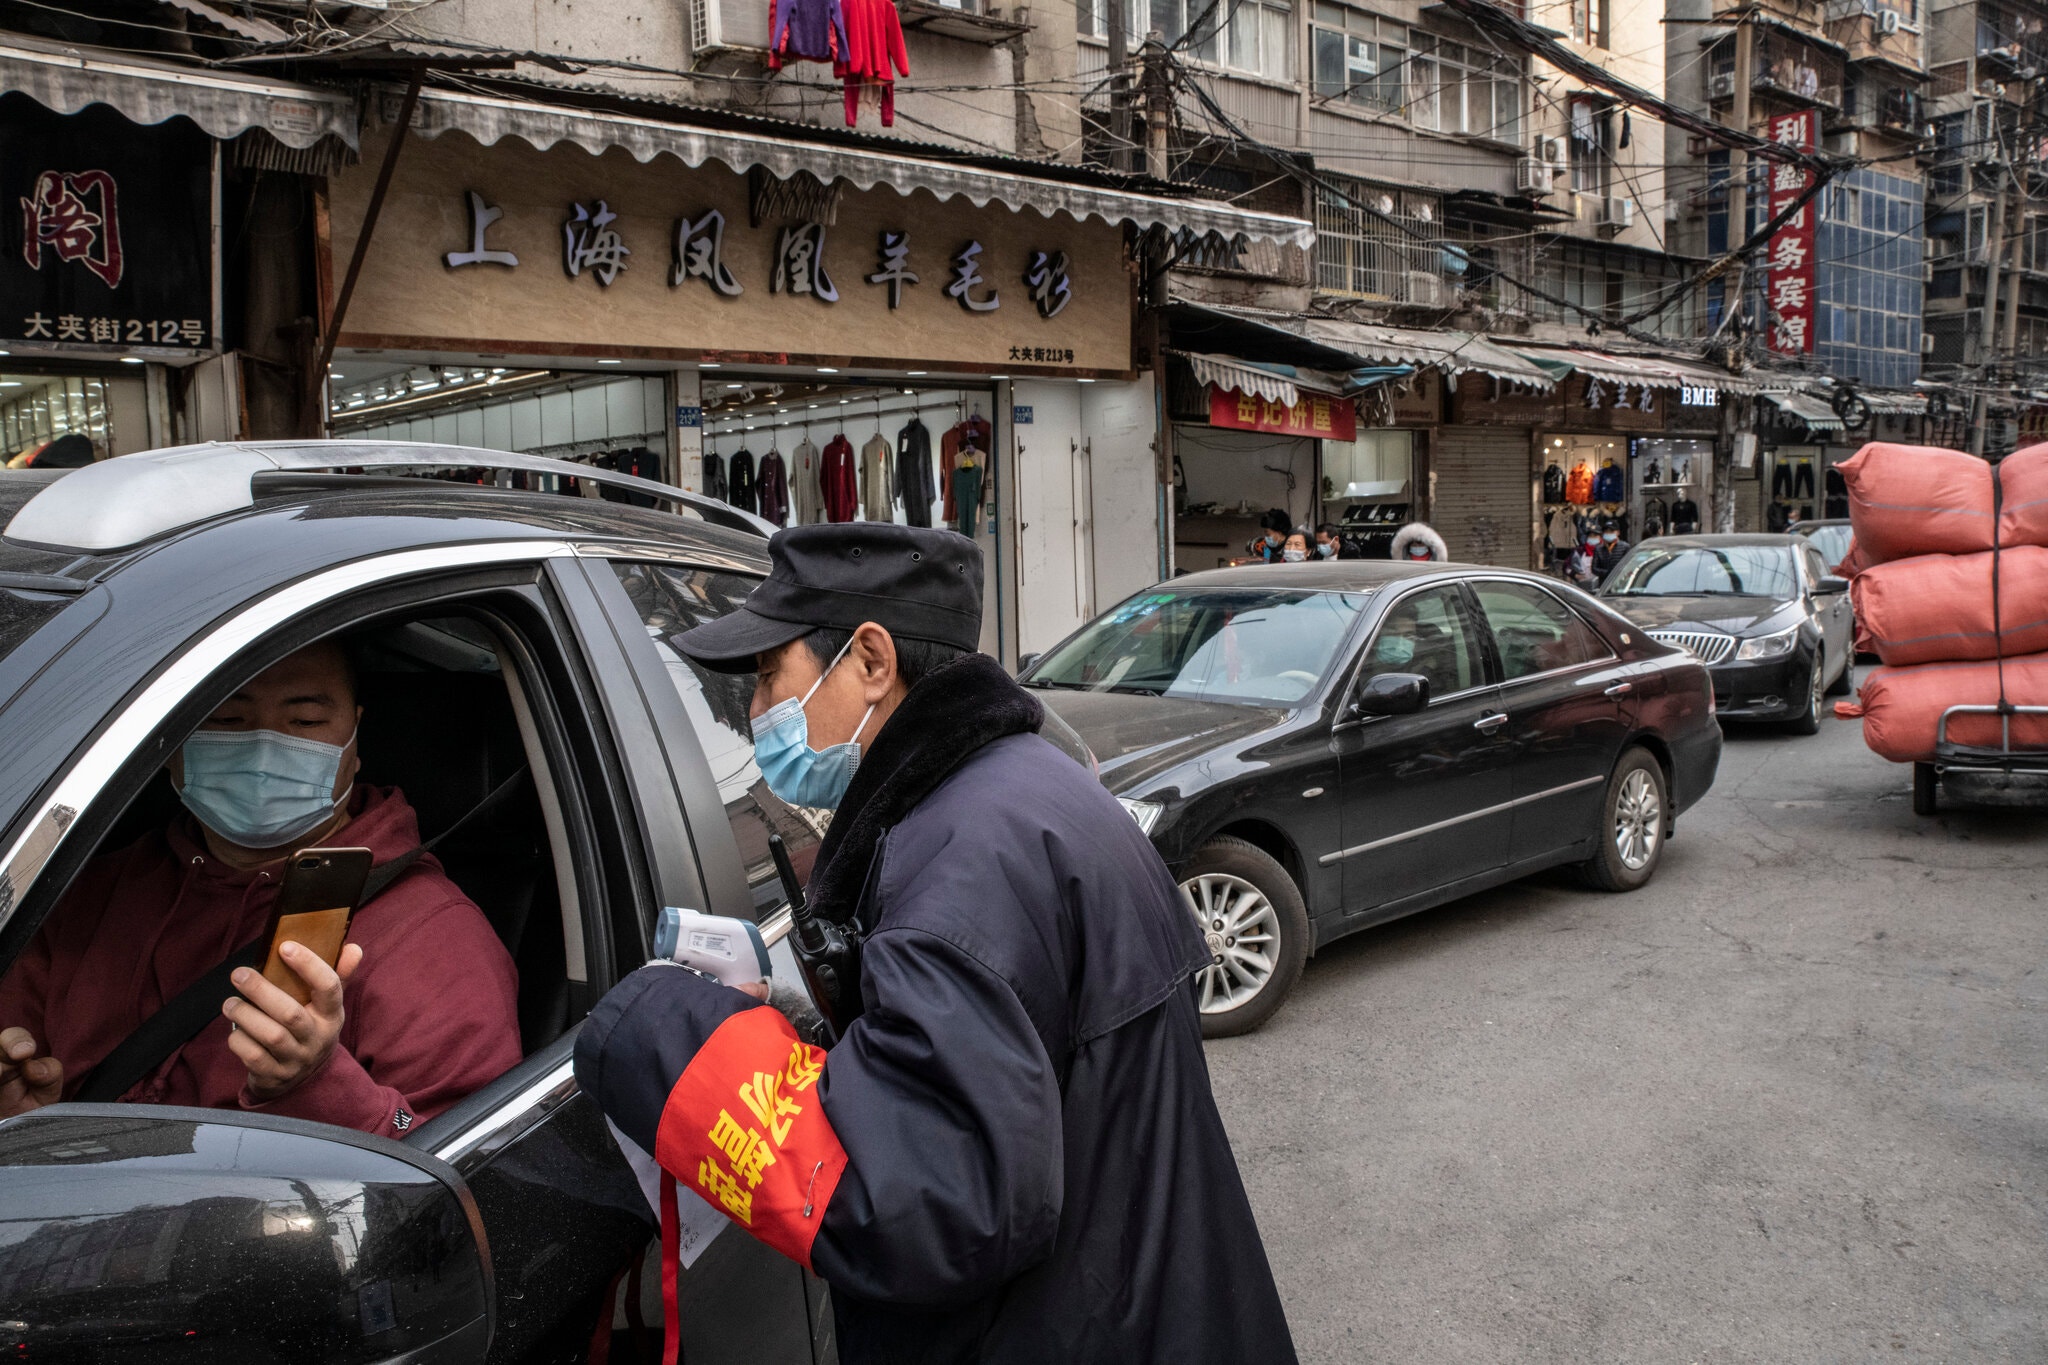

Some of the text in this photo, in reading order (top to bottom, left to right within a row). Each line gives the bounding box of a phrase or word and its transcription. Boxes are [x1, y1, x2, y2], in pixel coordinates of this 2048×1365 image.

[20, 170, 124, 289] 阁
[442, 190, 1072, 318] 上海凤凰羊毛衫
[24, 312, 206, 346] 大夹街212号
[1008, 345, 1074, 364] 大夹街213号
[1680, 386, 1720, 406] BMH
[698, 1042, 821, 1225] 市场管理
